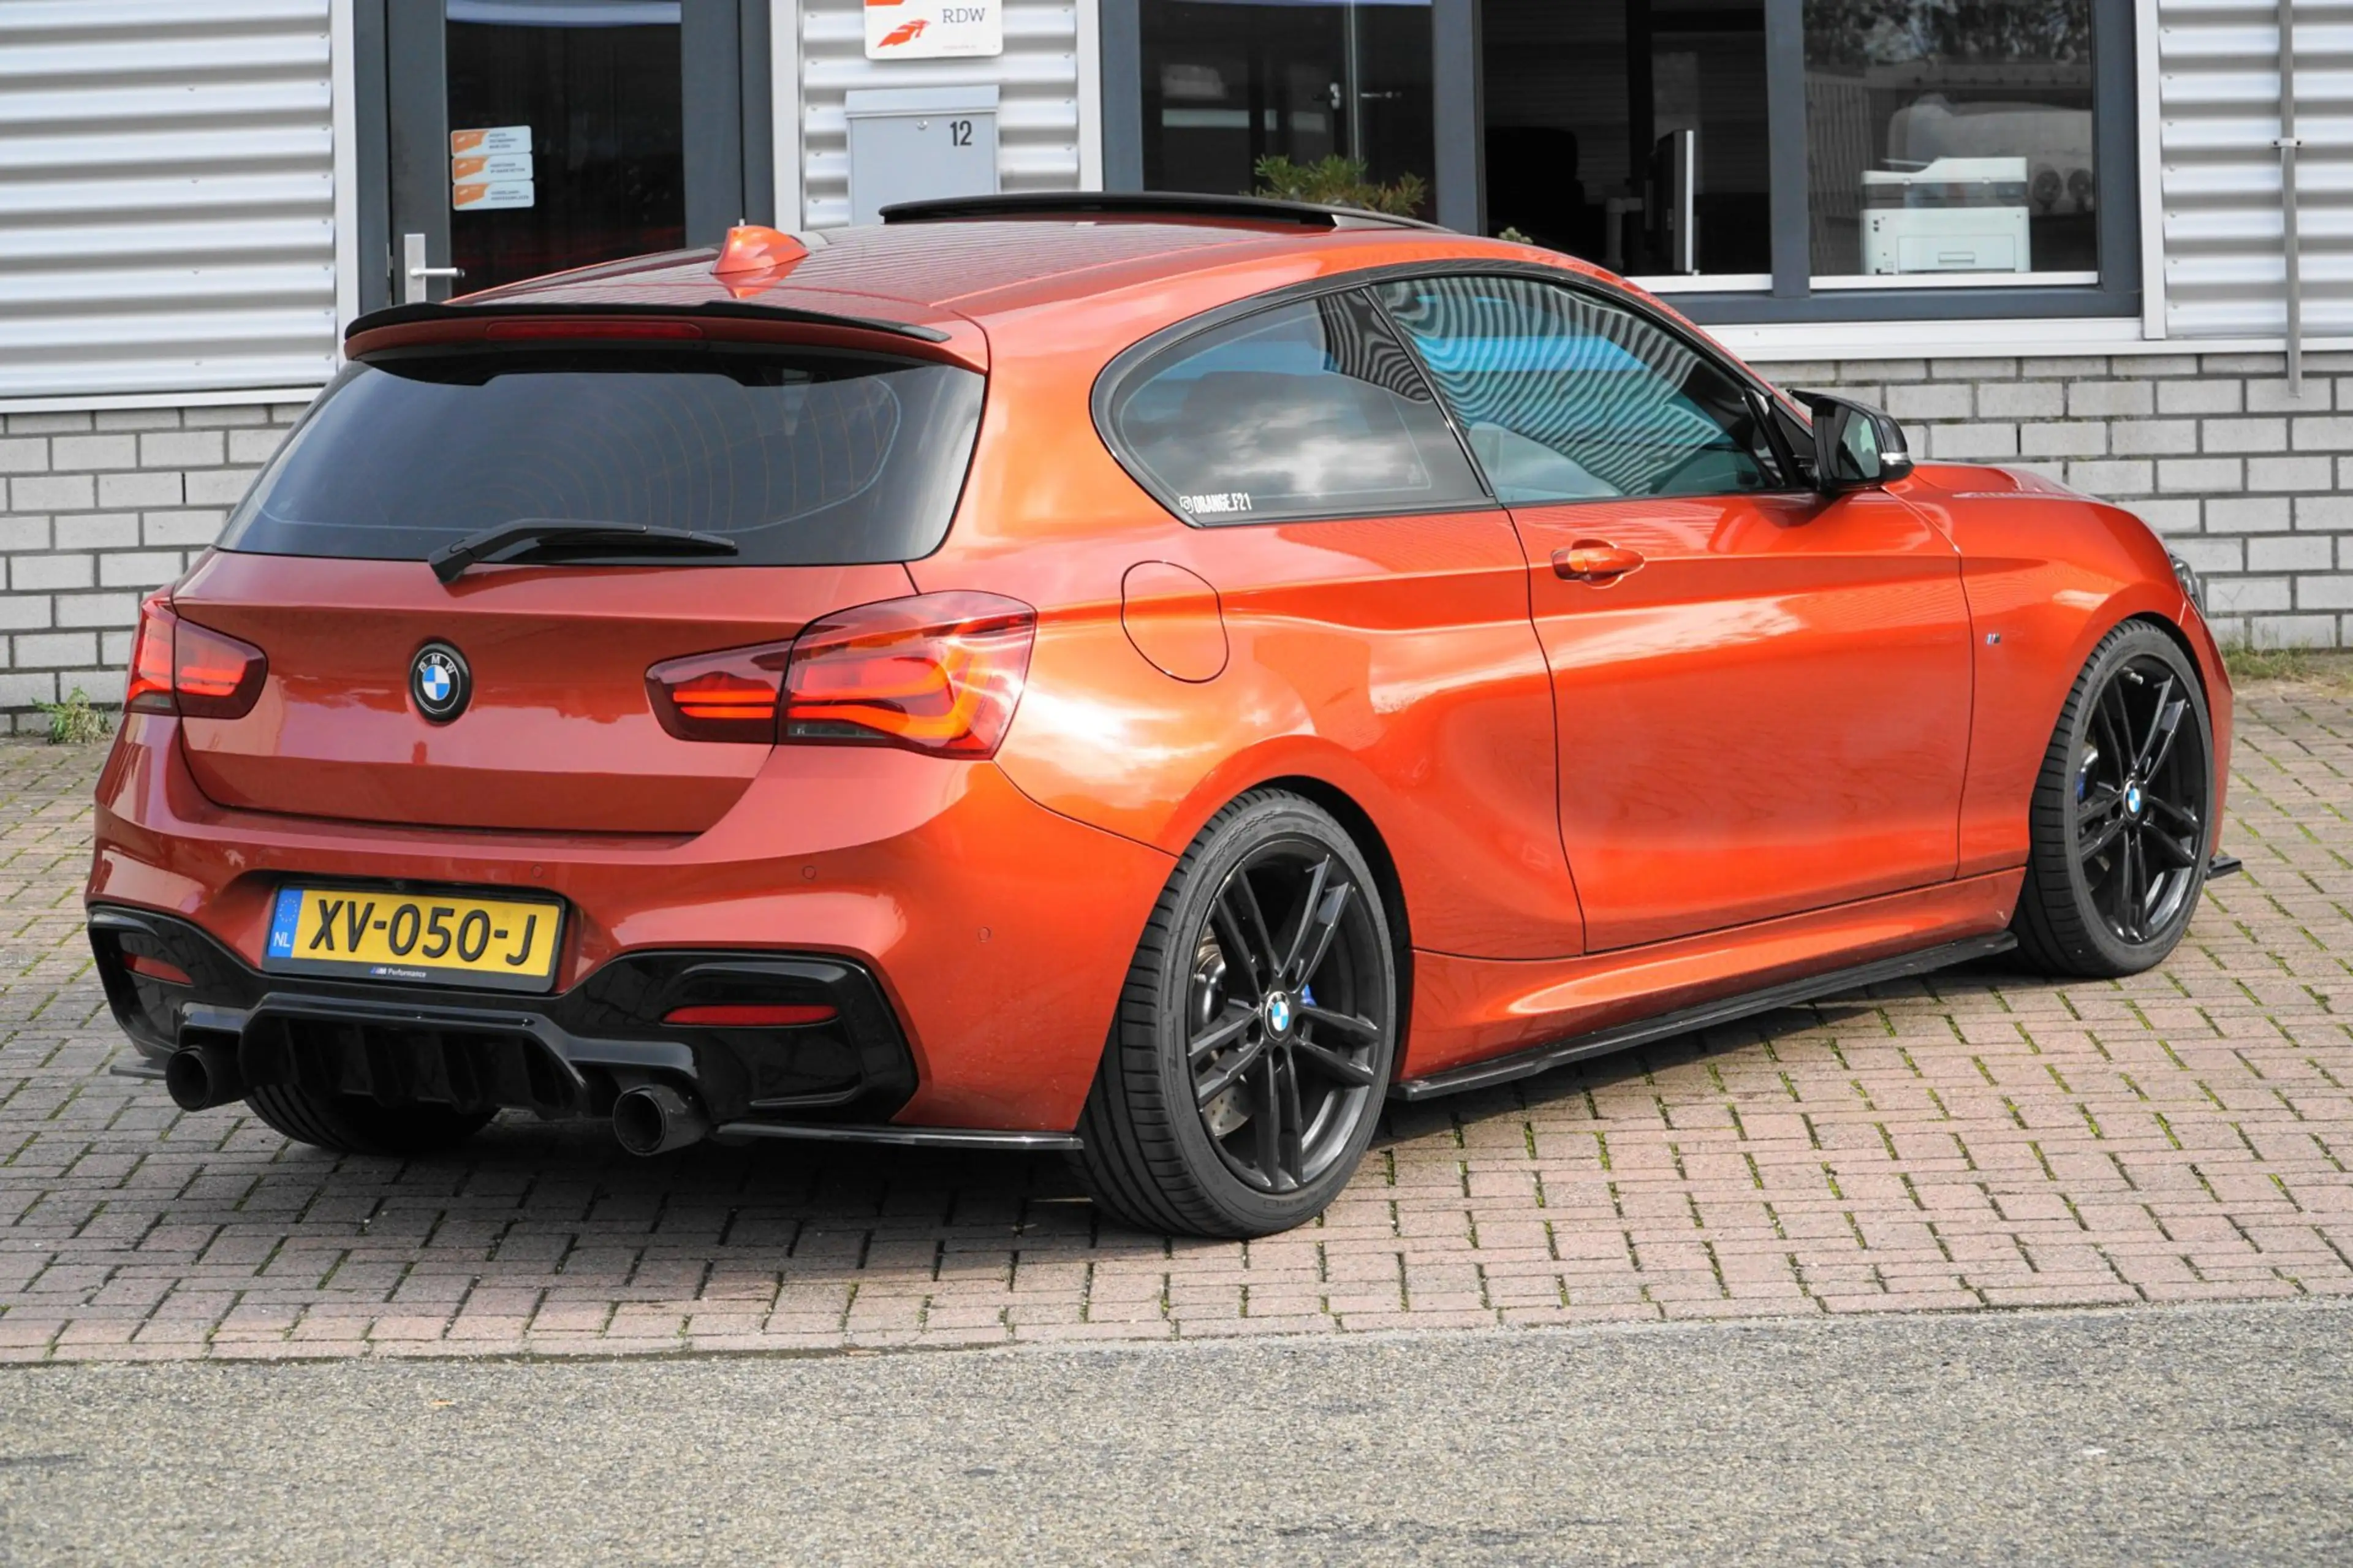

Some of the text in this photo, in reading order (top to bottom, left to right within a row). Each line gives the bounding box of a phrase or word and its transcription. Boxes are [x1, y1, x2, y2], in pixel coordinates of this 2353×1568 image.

[942, 7, 985, 23] RDW
[950, 121, 972, 146] 12
[418, 654, 455, 675] BMW
[273, 931, 290, 947] NL
[309, 899, 537, 966] XV-050-J
